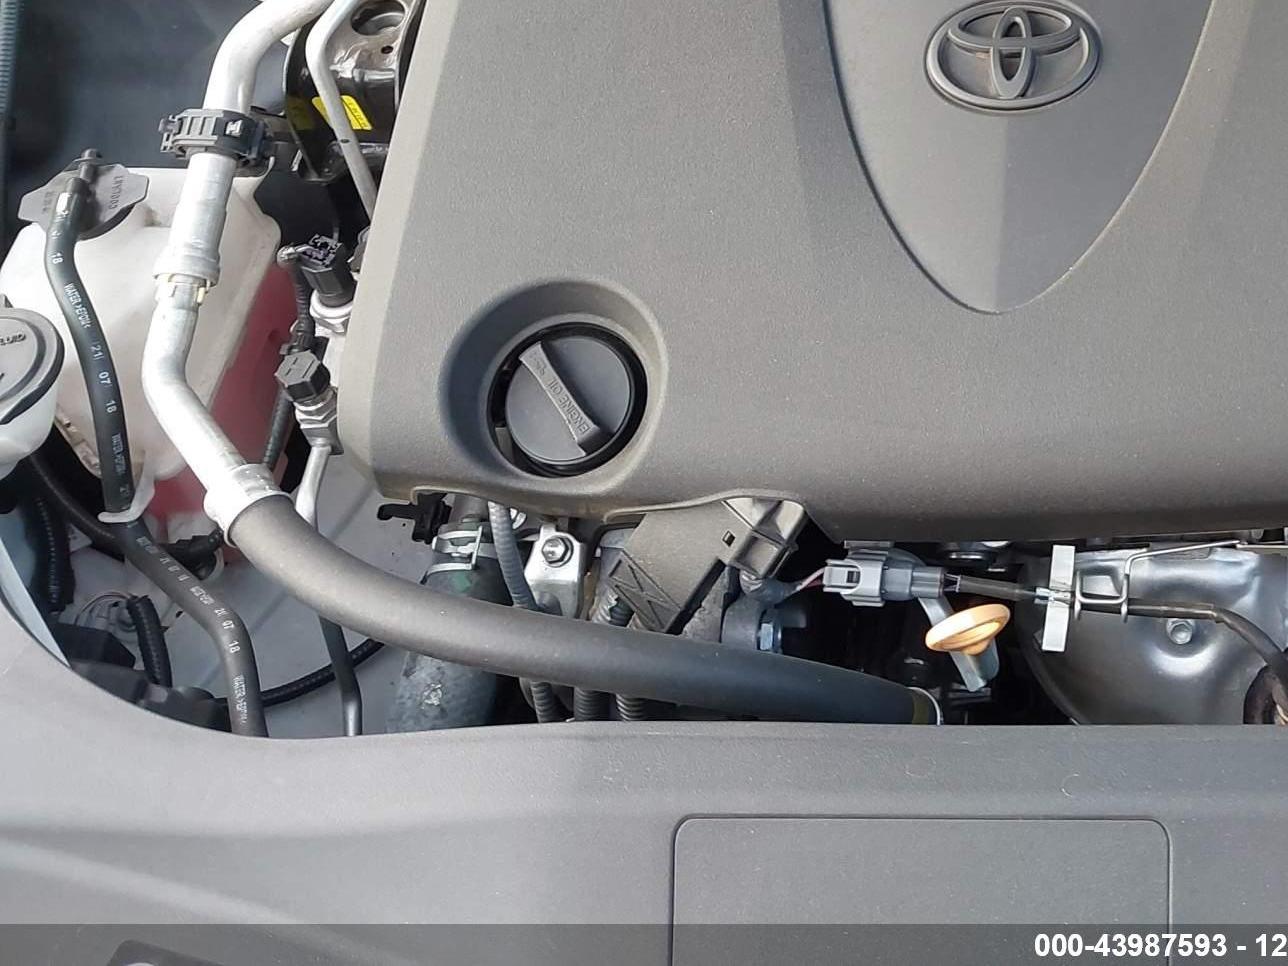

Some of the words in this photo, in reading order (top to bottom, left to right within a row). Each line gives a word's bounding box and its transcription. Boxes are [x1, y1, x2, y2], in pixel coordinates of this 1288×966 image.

[109, 175, 124, 210] COOLANT
[548, 377, 564, 396] OIL
[105, 400, 118, 414] 18
[559, 393, 591, 435] ENGINE
[228, 640, 240, 654] 18
